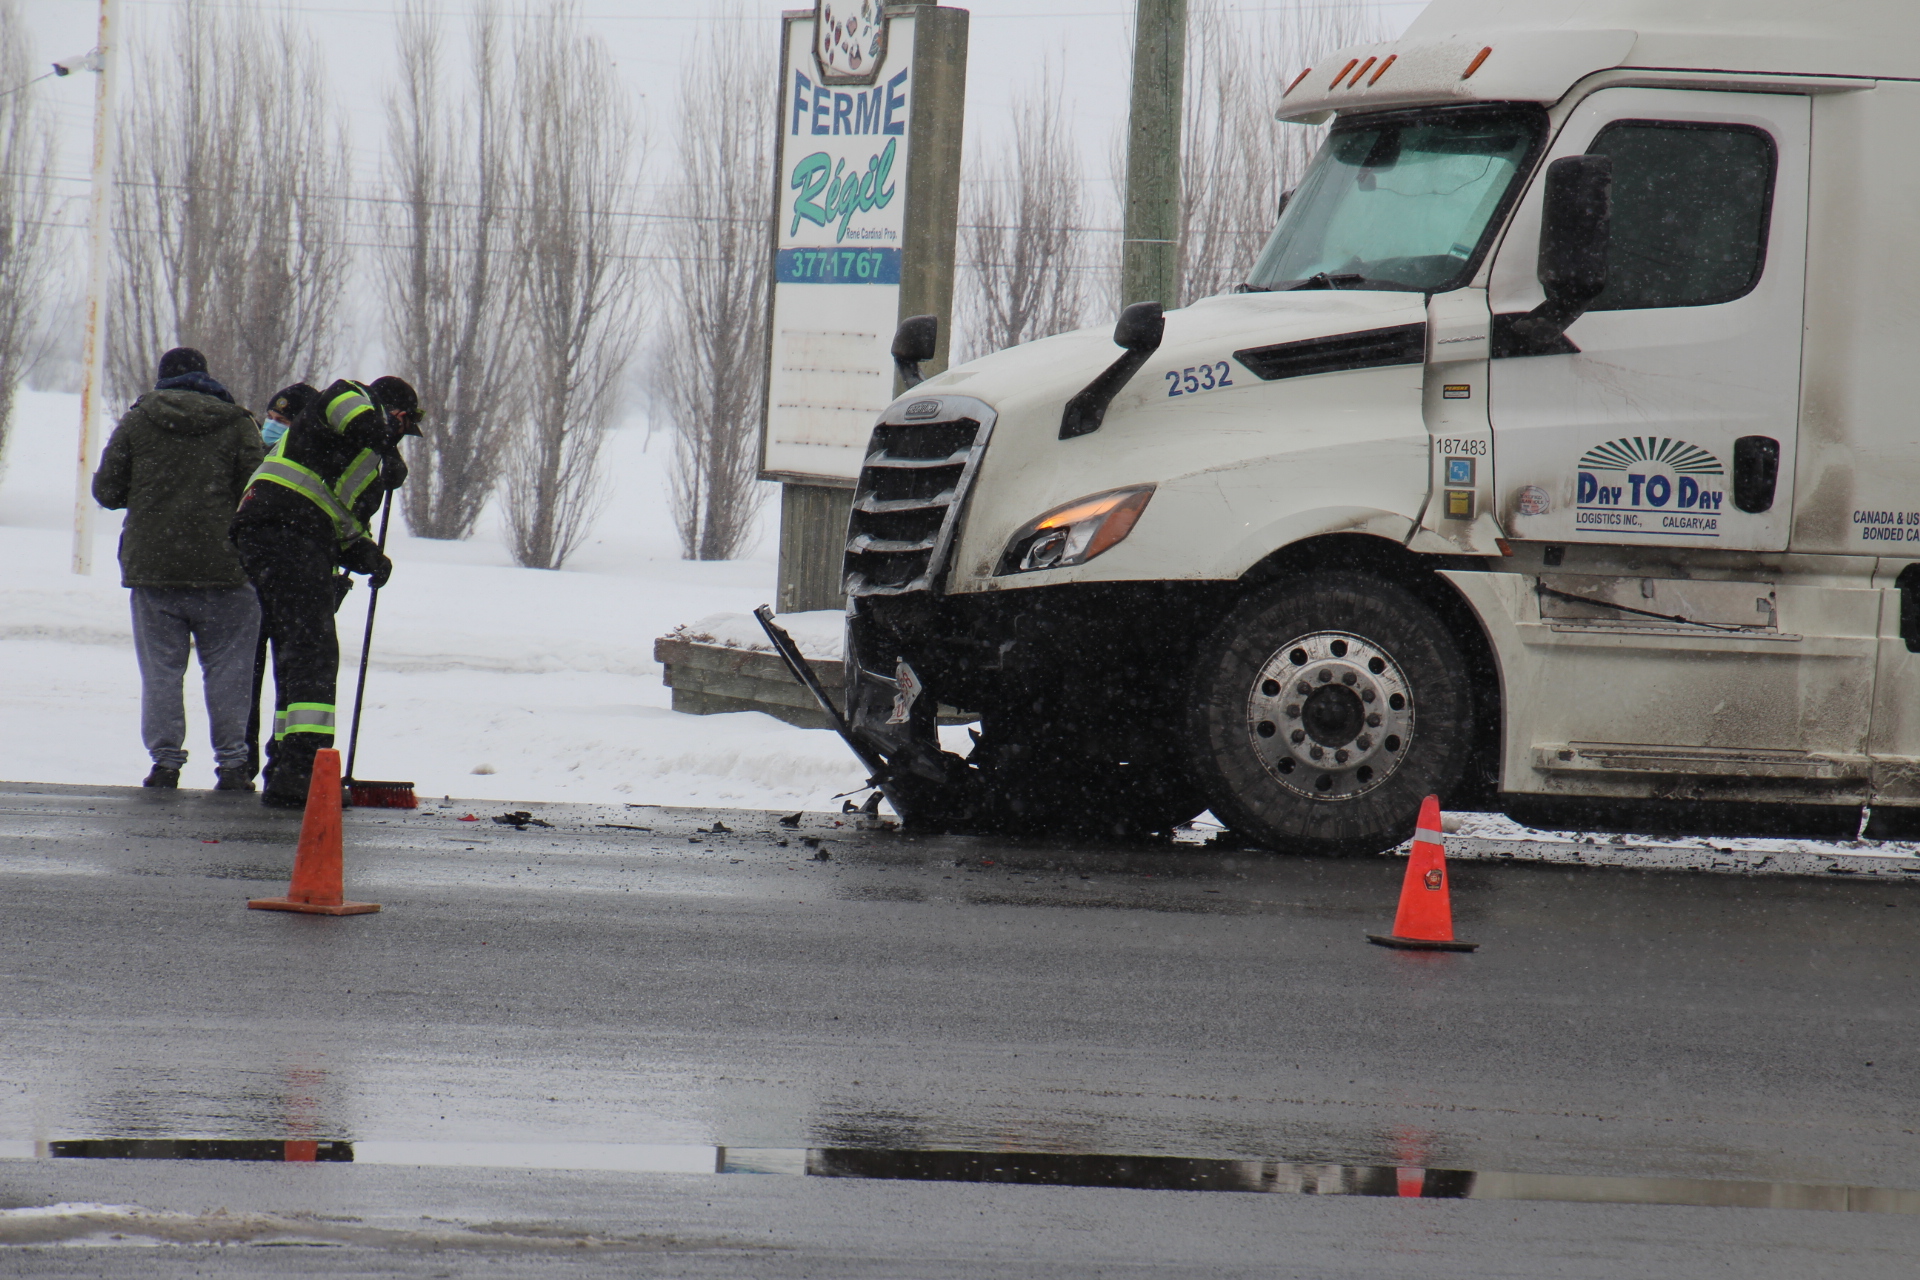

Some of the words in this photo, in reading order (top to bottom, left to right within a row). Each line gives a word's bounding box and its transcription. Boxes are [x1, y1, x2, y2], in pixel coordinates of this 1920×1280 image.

[792, 67, 908, 135] FERME
[790, 137, 896, 243] Régil
[1165, 360, 1233, 397] 2532
[1436, 438, 1487, 456] 187483
[1628, 473, 1672, 508] TO
[1576, 512, 1621, 525] LOGISTICS
[1853, 510, 1894, 524] CANADA
[1896, 511, 1904, 525] &
[1862, 526, 1904, 541] BONDED
